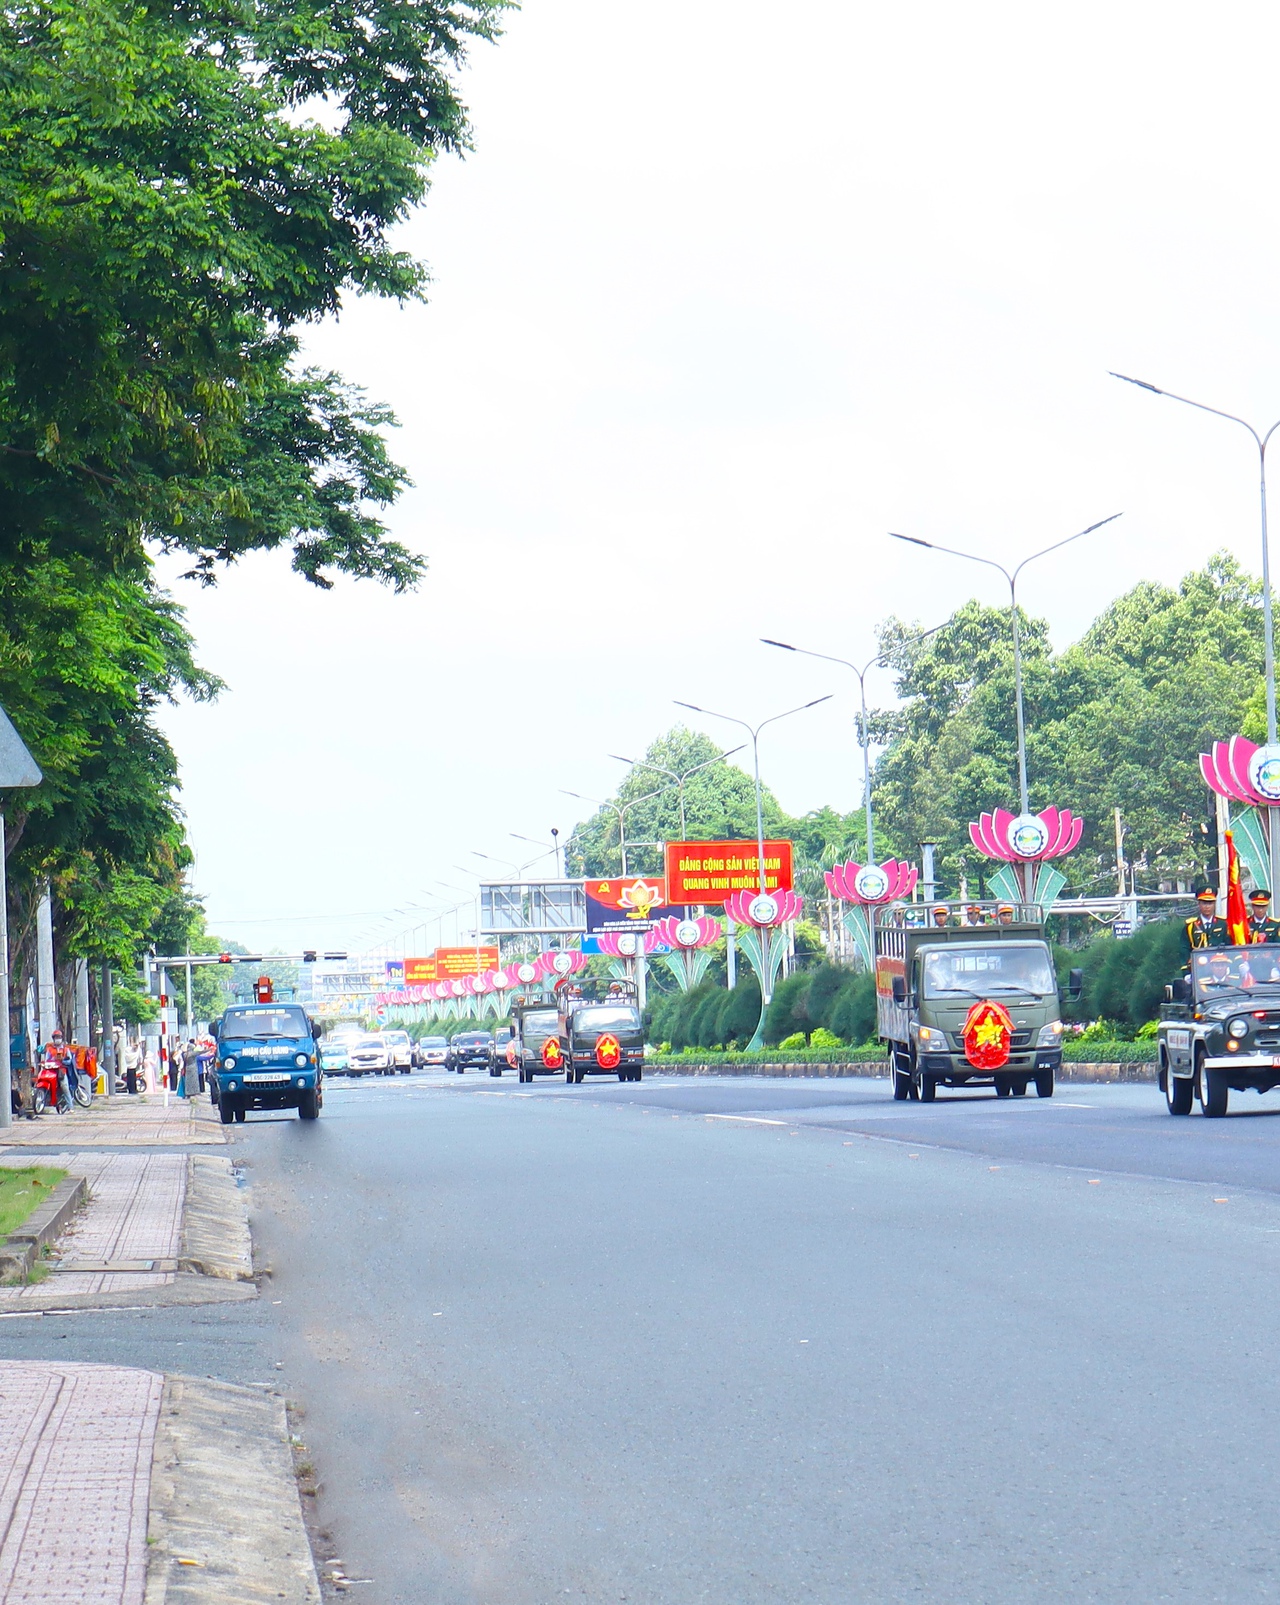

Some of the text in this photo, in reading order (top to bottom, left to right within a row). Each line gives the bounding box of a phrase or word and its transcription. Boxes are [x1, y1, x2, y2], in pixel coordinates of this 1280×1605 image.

[679, 856, 701, 871] ĐẢNG
[703, 857, 724, 873] CỘNG
[726, 855, 742, 871] SẢN
[683, 877, 709, 890] QUANG
[711, 877, 729, 889] VINH
[731, 875, 755, 889] MUÔN
